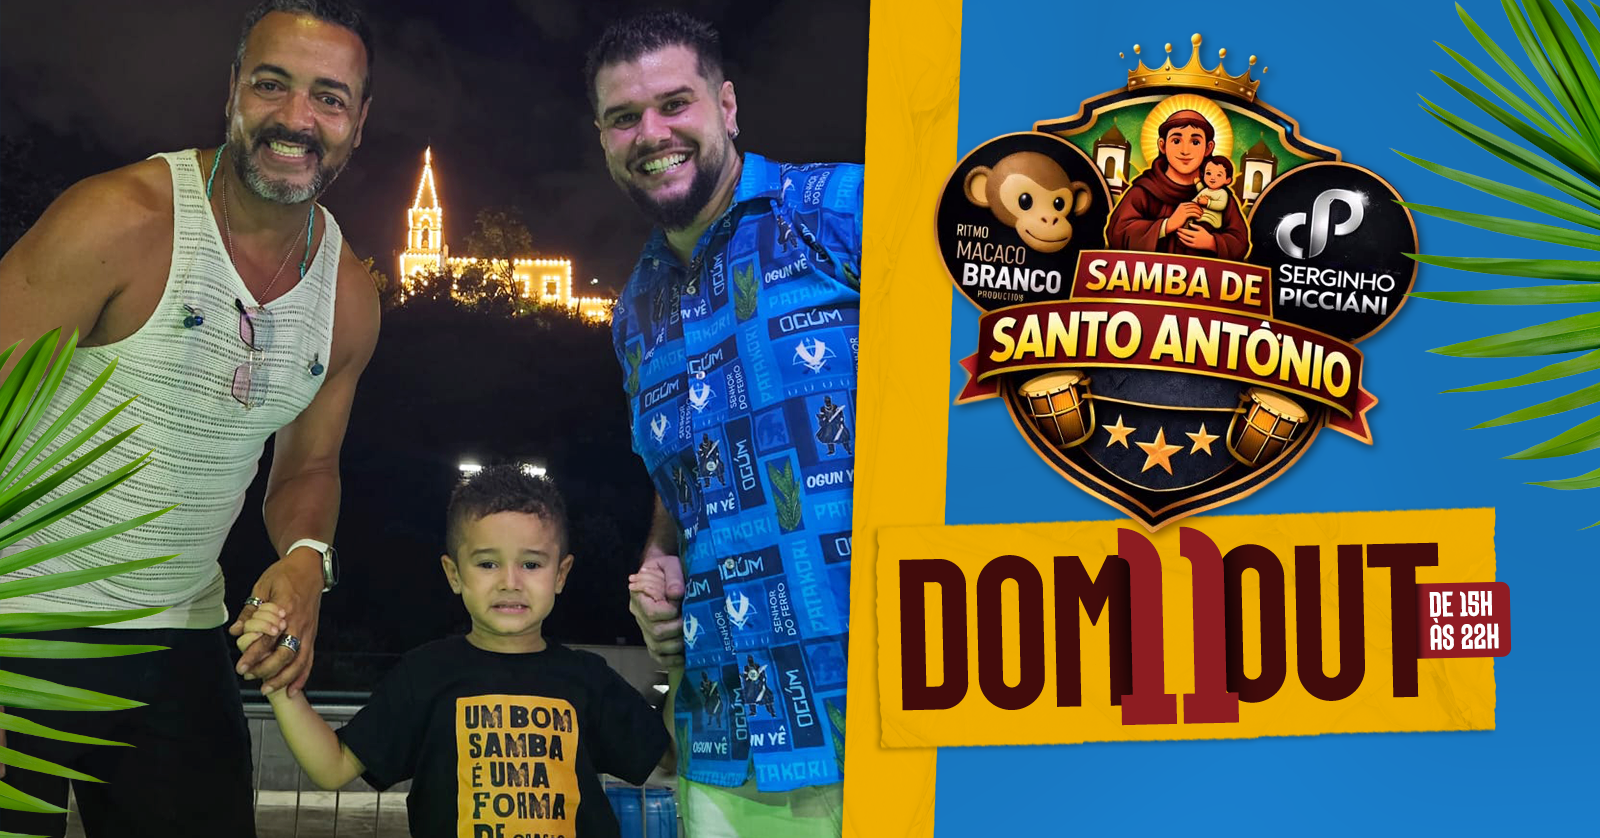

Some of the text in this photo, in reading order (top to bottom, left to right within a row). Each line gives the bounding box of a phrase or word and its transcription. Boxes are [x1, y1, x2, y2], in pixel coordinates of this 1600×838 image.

[804, 175, 818, 204] SENHOR
[812, 172, 830, 205] DO FERRO
[765, 253, 808, 284] OGUN YÊ
[694, 298, 707, 318] YÊ
[780, 308, 842, 332] OGÚM
[644, 379, 679, 408] OGÚM
[726, 372, 738, 408] SENHOR
[733, 365, 748, 410] DO FERRO
[734, 439, 756, 491] OGÚM
[806, 471, 843, 488] OGUN
[720, 491, 736, 512] YÊ
[792, 540, 830, 633] PATAKORI
[769, 590, 784, 633] SENHOR
[777, 582, 797, 636] DO FERRO
[714, 611, 731, 652] SENHOR
[785, 668, 814, 728] OGÚM
[465, 704, 572, 733] UM BOM
[732, 688, 748, 740] OGÚM
[469, 732, 564, 762] SAMBA
[714, 737, 728, 754] YÊ
[768, 725, 787, 747] YÊ
[472, 762, 550, 788] É UMA
[473, 792, 566, 820] FORMA
